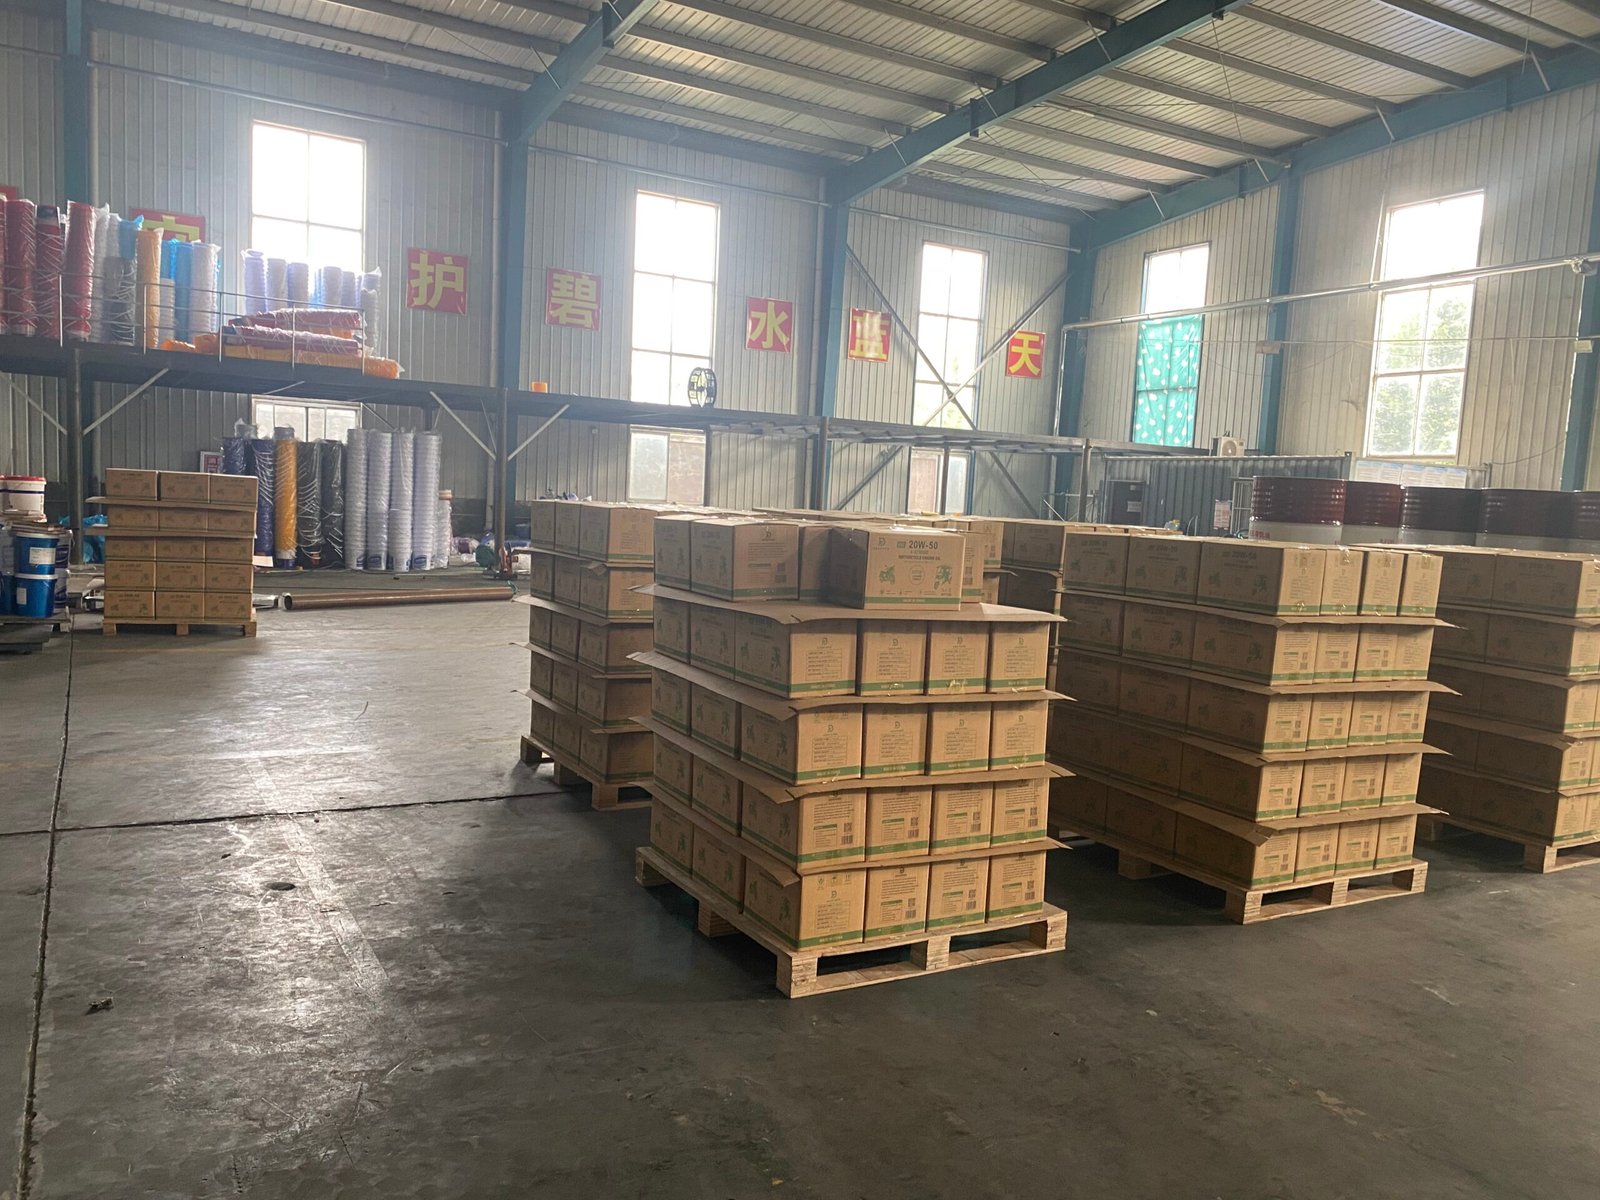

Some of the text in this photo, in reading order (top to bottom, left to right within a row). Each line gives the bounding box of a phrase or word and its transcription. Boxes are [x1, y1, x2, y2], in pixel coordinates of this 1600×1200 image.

[410, 251, 1041, 376] 护 碧 水 蓝 天
[908, 540, 938, 550] 20W-50
